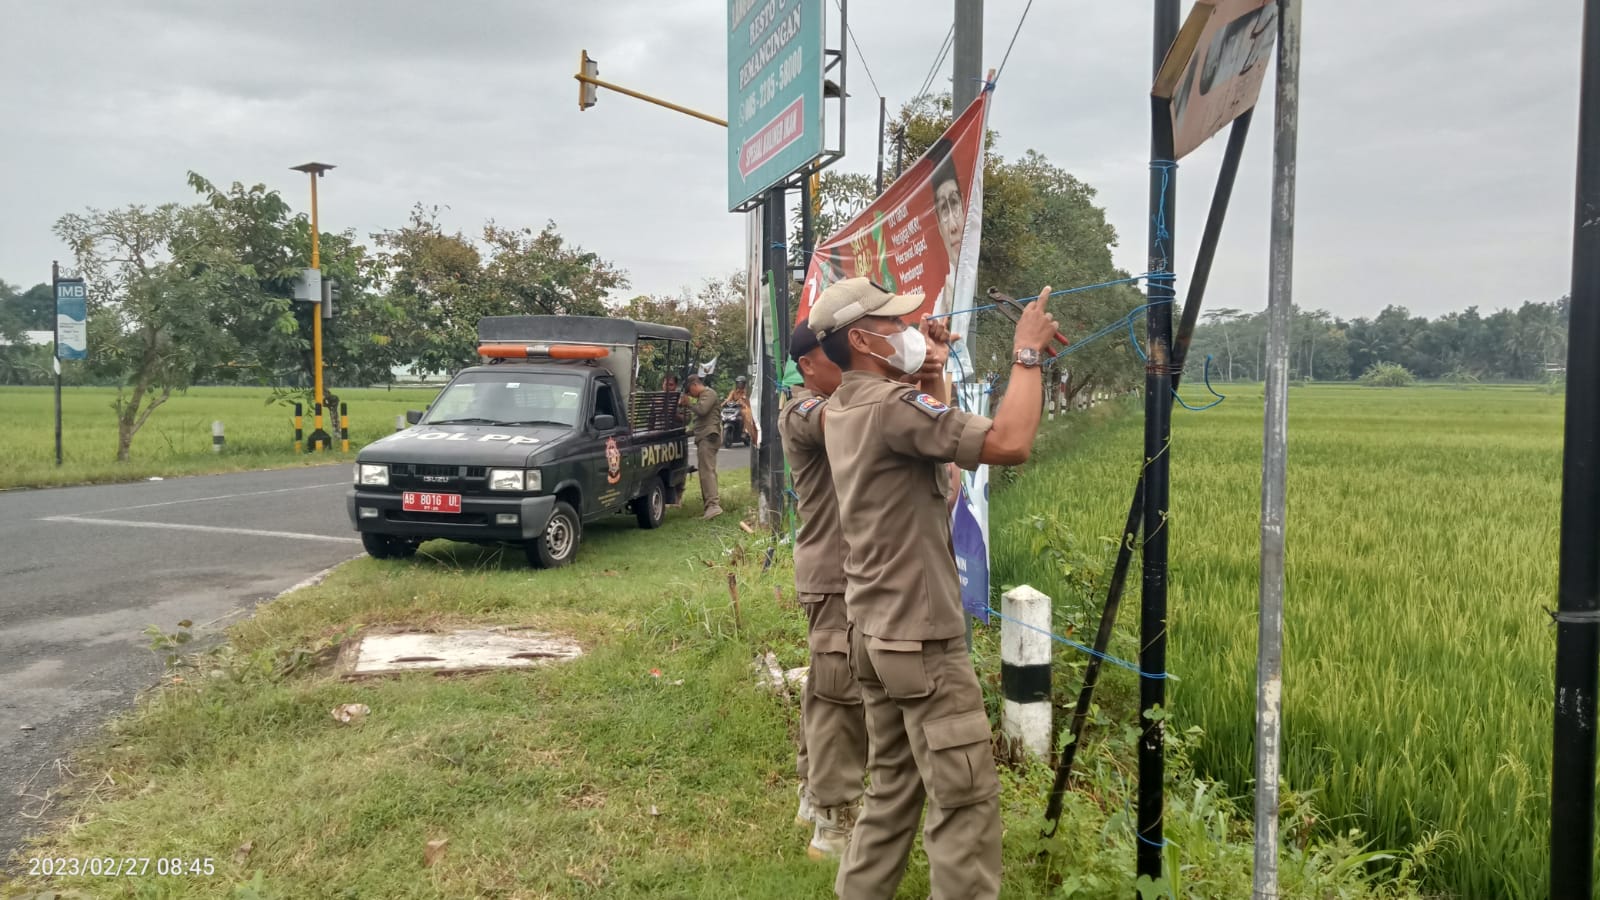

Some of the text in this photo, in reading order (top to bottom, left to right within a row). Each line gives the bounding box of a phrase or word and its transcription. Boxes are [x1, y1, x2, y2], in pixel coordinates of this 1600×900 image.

[750, 0, 775, 46] RESTO
[739, 3, 801, 90] PEMANCINGAN
[58, 286, 84, 297] IMB
[390, 432, 541, 445] POL PP
[641, 441, 684, 468] PATROLI
[404, 493, 415, 505] AB
[448, 495, 460, 507] UL
